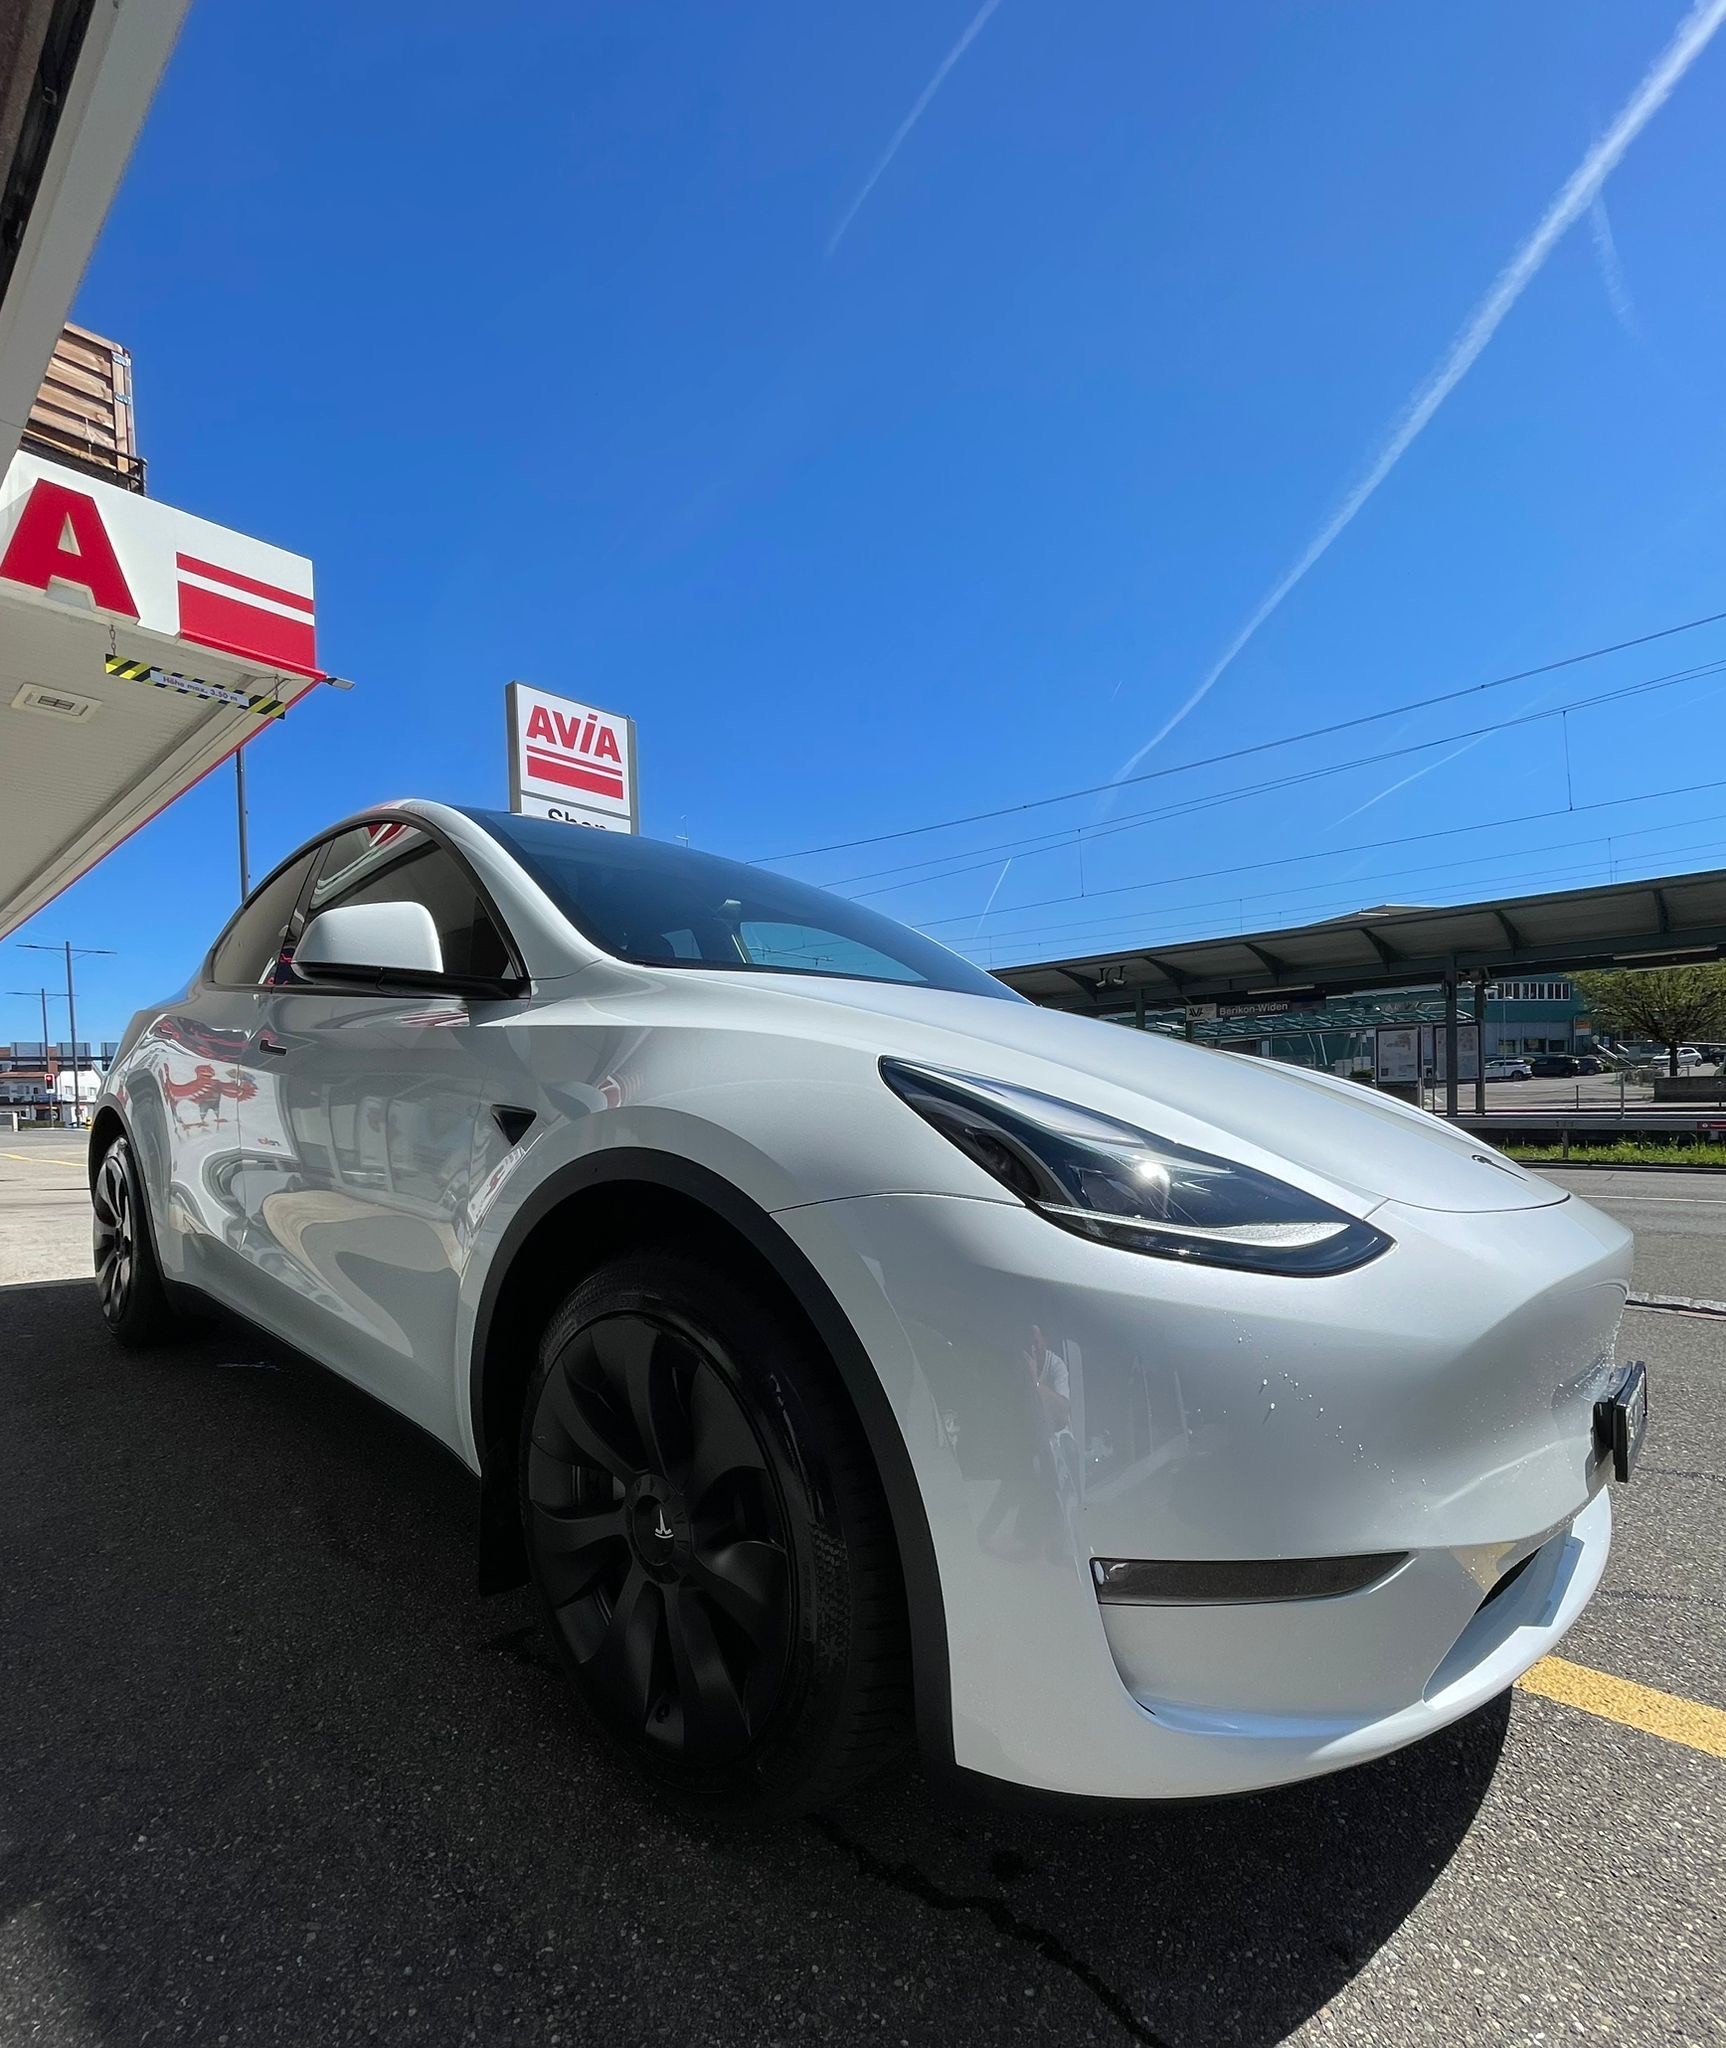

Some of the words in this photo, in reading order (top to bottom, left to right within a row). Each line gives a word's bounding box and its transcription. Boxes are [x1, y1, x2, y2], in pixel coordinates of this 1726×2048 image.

[0, 478, 141, 619] A
[162, 675, 185, 688] Höhe
[187, 683, 208, 694] max.
[1219, 1002, 1288, 1016] Berikon-Widen
